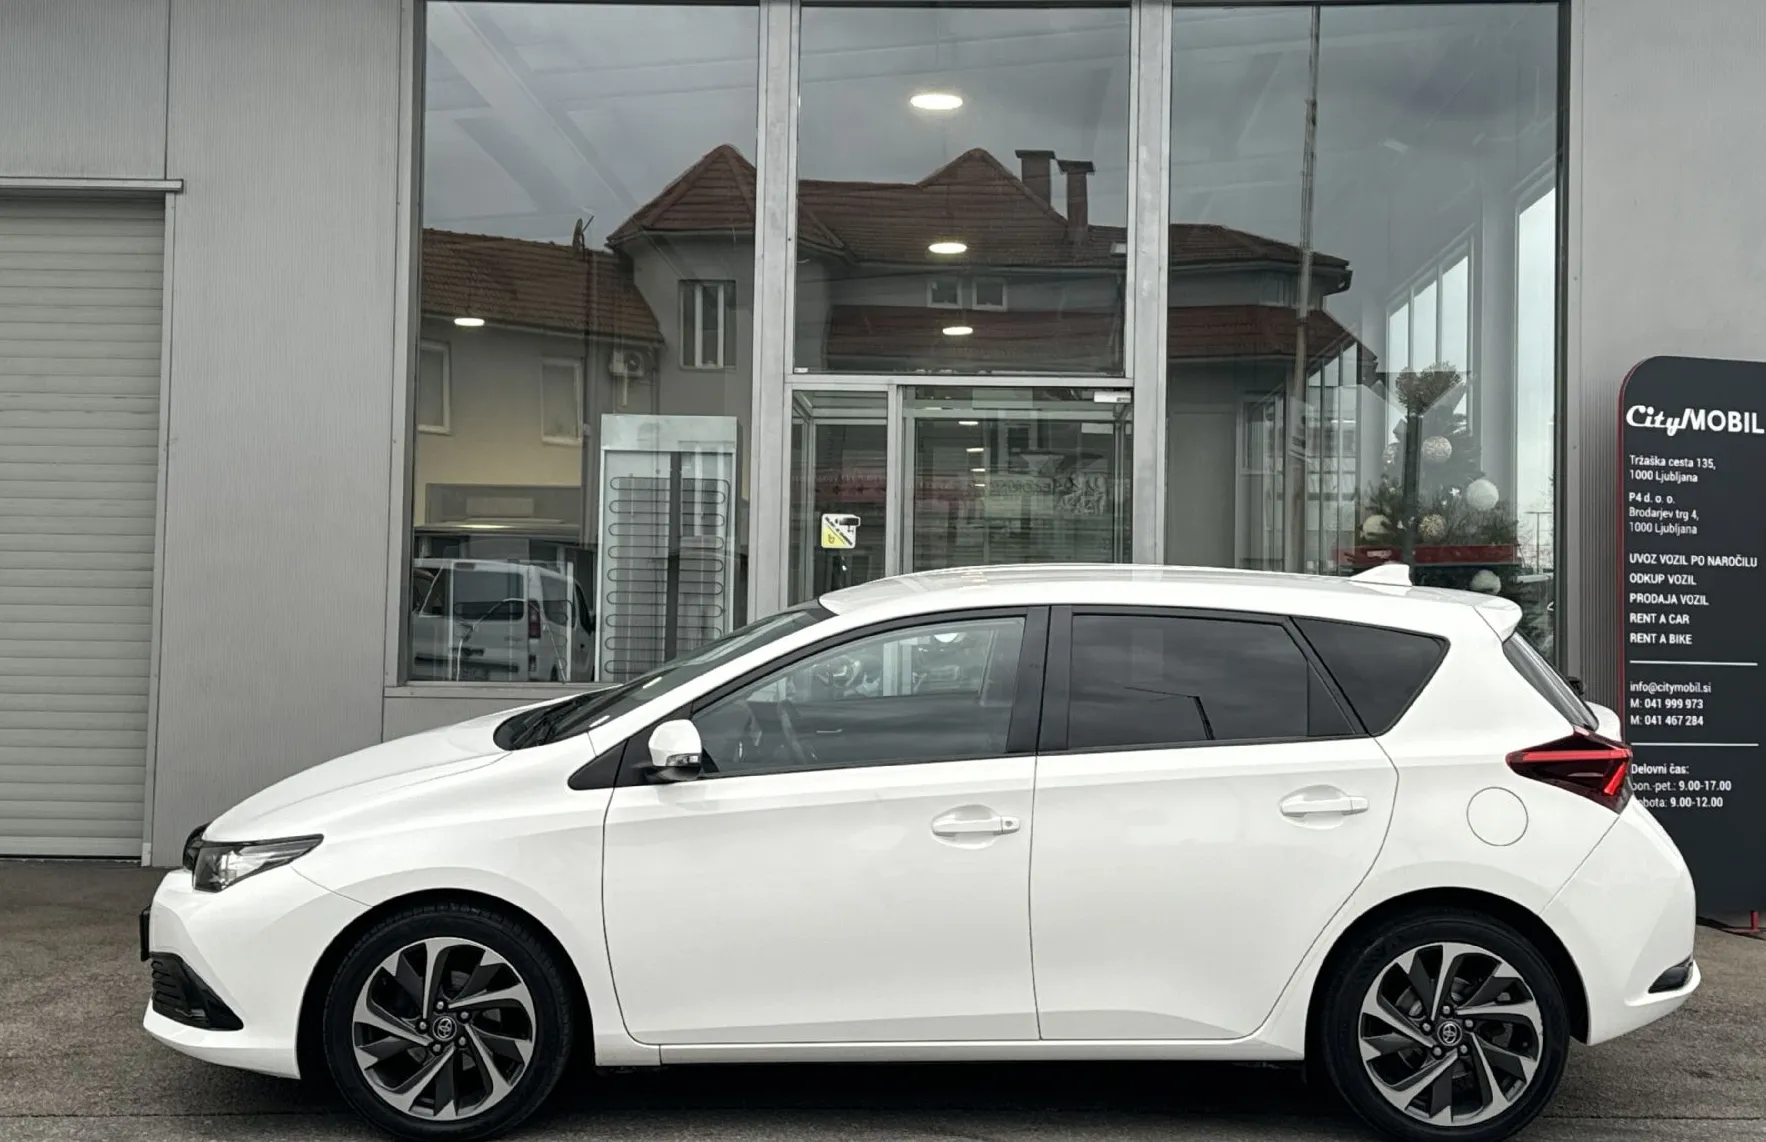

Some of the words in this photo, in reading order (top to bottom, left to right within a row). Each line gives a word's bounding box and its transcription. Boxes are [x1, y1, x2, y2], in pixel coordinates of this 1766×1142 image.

[1626, 405, 1765, 436] CityMOBIL
[1630, 455, 1666, 467] Tržaška
[1668, 458, 1694, 468] cesta
[1697, 458, 1716, 470] 135,
[1630, 470, 1653, 481] 1000
[1656, 470, 1698, 484] Ljubljana
[1629, 492, 1642, 503] P4
[1644, 492, 1654, 503] d.
[1656, 495, 1664, 504] o.
[1667, 495, 1676, 504] o.
[1629, 507, 1674, 519] Brodarjev
[1676, 509, 1689, 521] trg
[1691, 509, 1700, 521] 4,
[1630, 522, 1653, 533] 1000
[1655, 523, 1698, 536] Ljubljana
[1630, 553, 1658, 565] UVOZ
[1659, 554, 1689, 566] VOZIL
[1691, 555, 1705, 566] PO
[1708, 554, 1758, 567] NAROČILU
[1630, 573, 1665, 584] ODKUP
[1667, 574, 1697, 586] VOZIL
[1630, 593, 1678, 605] PRODAJA
[1680, 594, 1709, 606] VOZIL
[1630, 613, 1657, 624] RENT
[1659, 614, 1667, 624] A
[1669, 614, 1690, 625] CAR
[1630, 633, 1657, 644] RENT
[1659, 634, 1667, 644] A
[1669, 634, 1693, 645] BIKE
[1630, 681, 1712, 695] info@citymobil.si
[1630, 699, 1643, 709] M:
[1644, 699, 1663, 709] 041
[1665, 699, 1684, 709] 999
[1686, 699, 1704, 709] 973
[1630, 716, 1643, 726] M:
[1644, 716, 1663, 726] 041
[1665, 716, 1684, 726] 467
[1686, 716, 1704, 726] 284
[1631, 763, 1668, 775] Delovni
[1670, 763, 1690, 775] čas:
[1678, 780, 1732, 792] 9.00-17.00
[1639, 796, 1668, 808] bota:
[1670, 797, 1724, 808] 9.00-12.00
